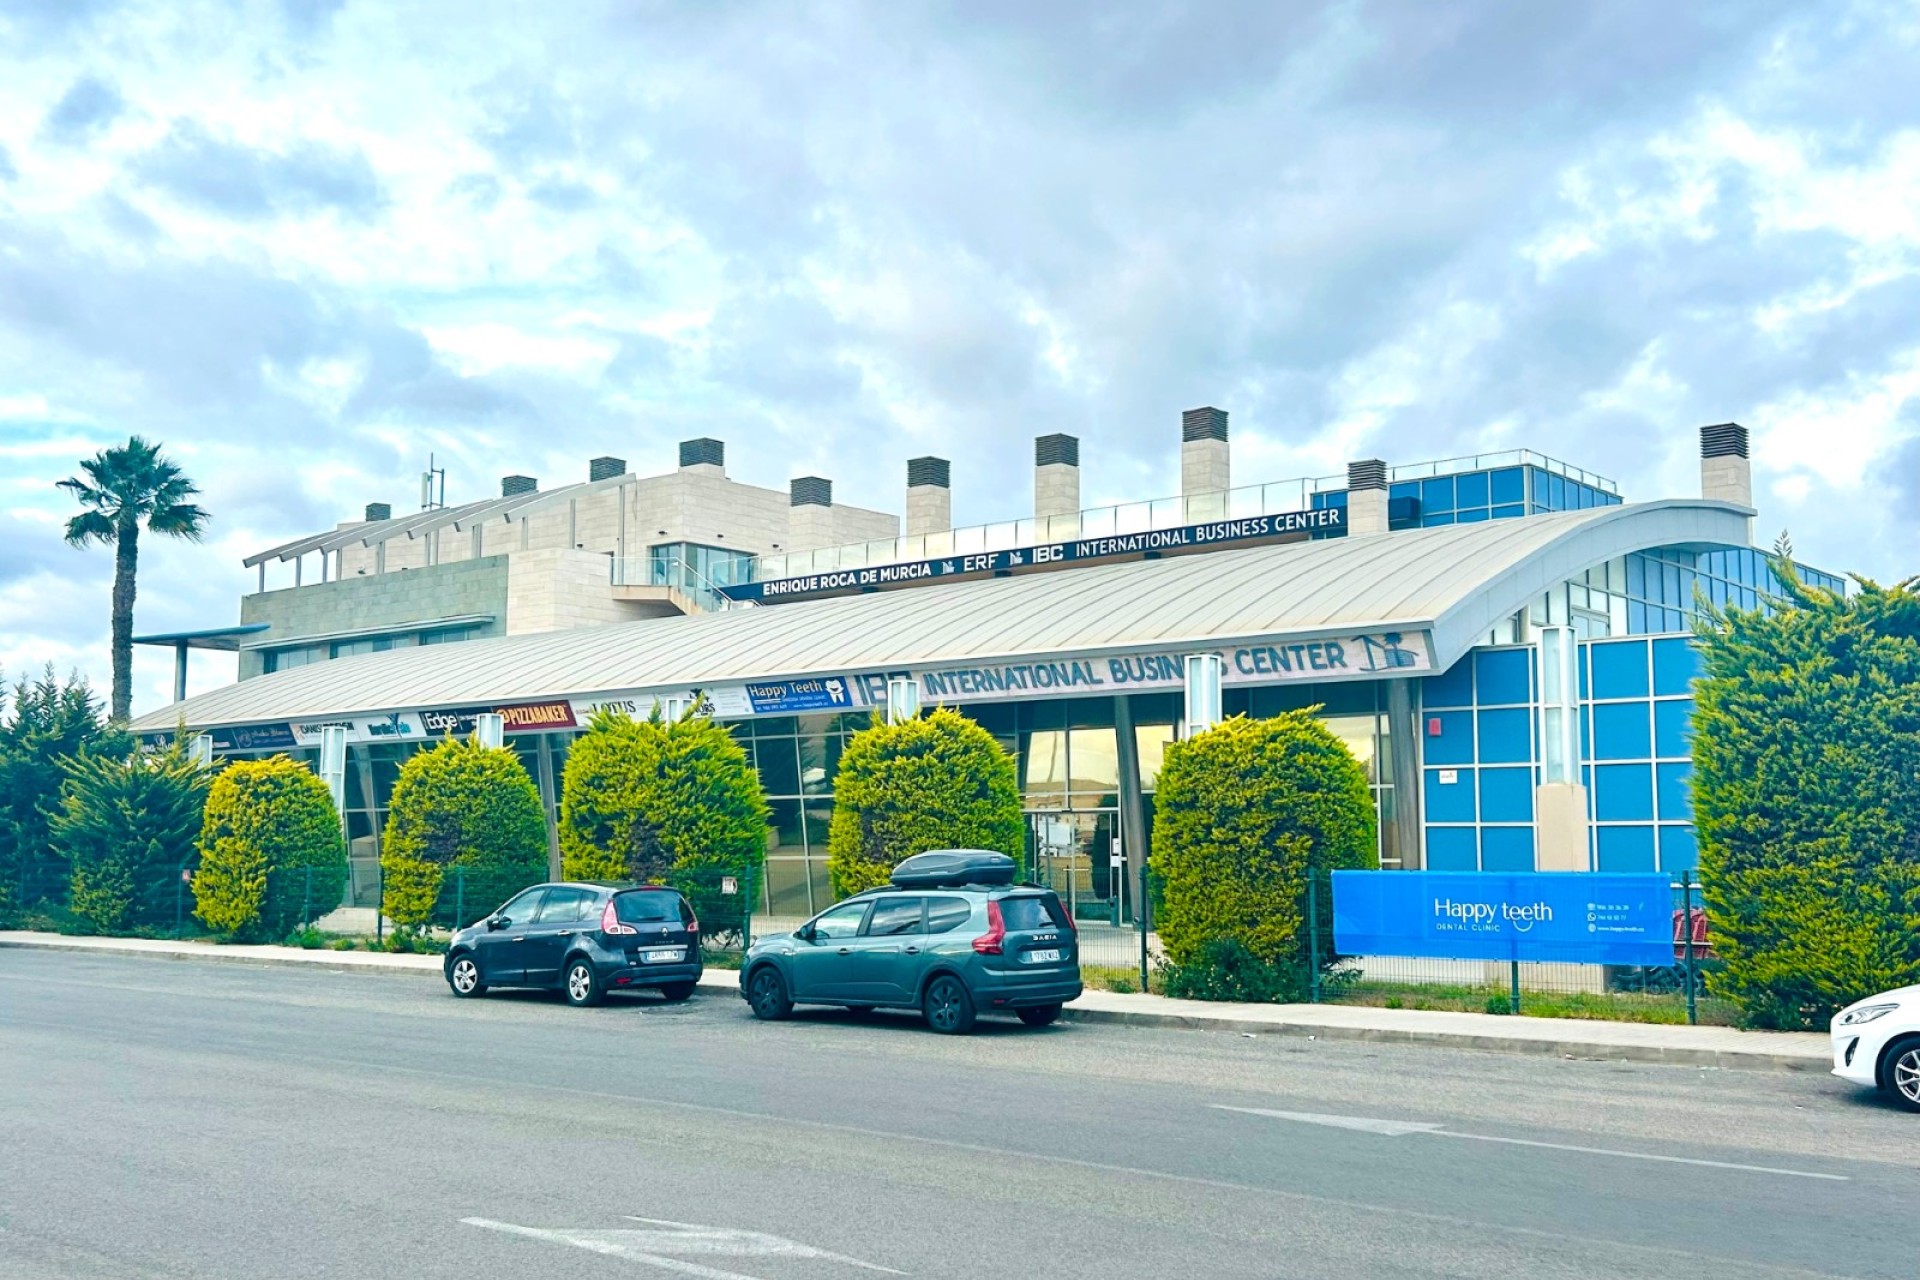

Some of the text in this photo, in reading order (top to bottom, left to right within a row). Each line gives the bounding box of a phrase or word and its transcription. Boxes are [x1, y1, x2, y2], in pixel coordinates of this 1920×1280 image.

[763, 508, 1340, 596] ENRIQUE ROCA DE MURCIA ERF IBC INTERNATIONAL BUSINESS CENTER
[854, 641, 1348, 706] IB INTERNATIONAL BUSINS CENTER
[749, 680, 823, 699] Happy Teeth
[510, 705, 568, 725] PIZZABAKER
[592, 700, 637, 714] LOTUS
[426, 712, 458, 730] Edge
[1434, 898, 1553, 923] Happy teeth
[1436, 923, 1500, 932] DENTAL CLINIC
